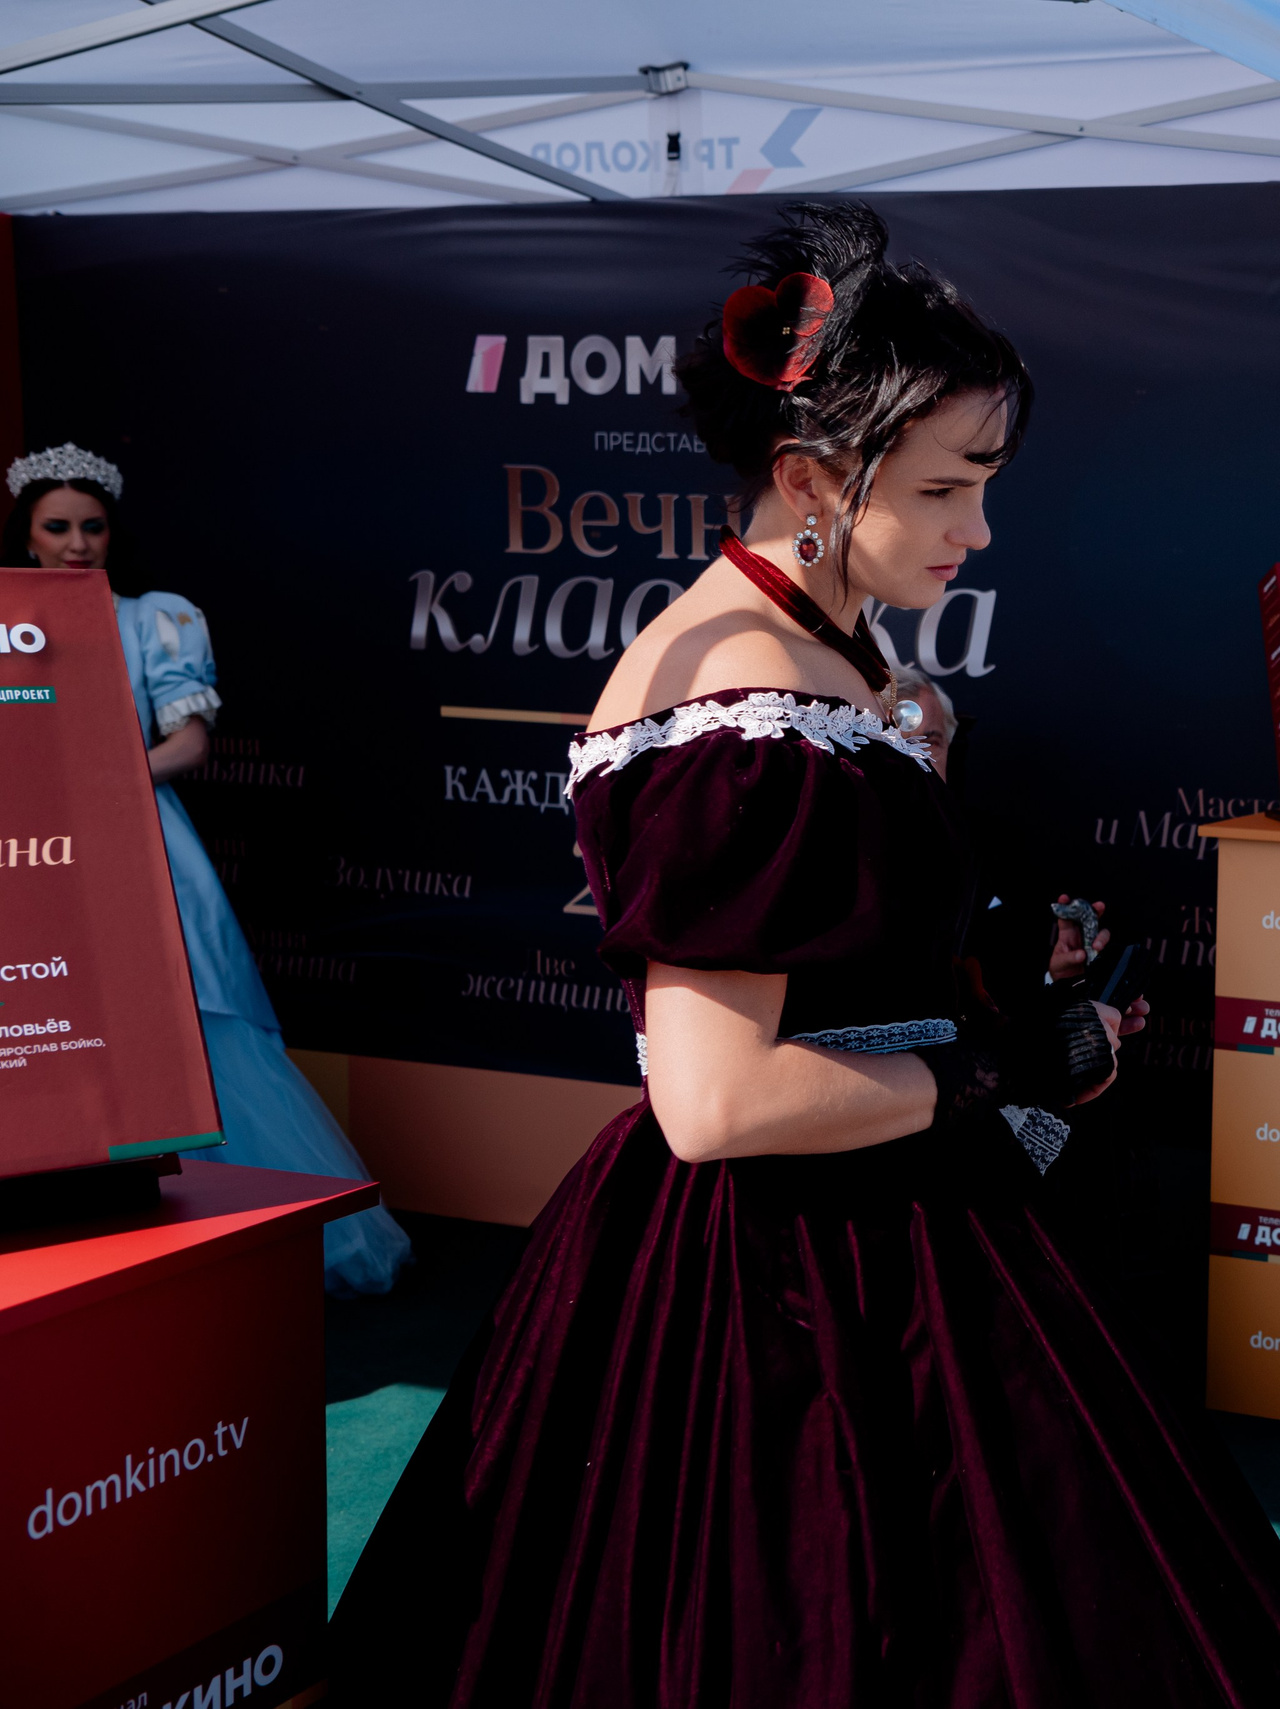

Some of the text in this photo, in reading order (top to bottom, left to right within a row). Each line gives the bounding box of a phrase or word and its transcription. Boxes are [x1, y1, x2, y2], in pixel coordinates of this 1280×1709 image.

[519, 334, 677, 405] ДОМ
[594, 430, 707, 455] ПРЕДСТАВ
[502, 463, 743, 561] Вечн
[407, 568, 997, 680] класка
[443, 763, 570, 816] КАЖД
[1094, 817, 1120, 846] и
[26, 1416, 250, 1541] domkino.tv
